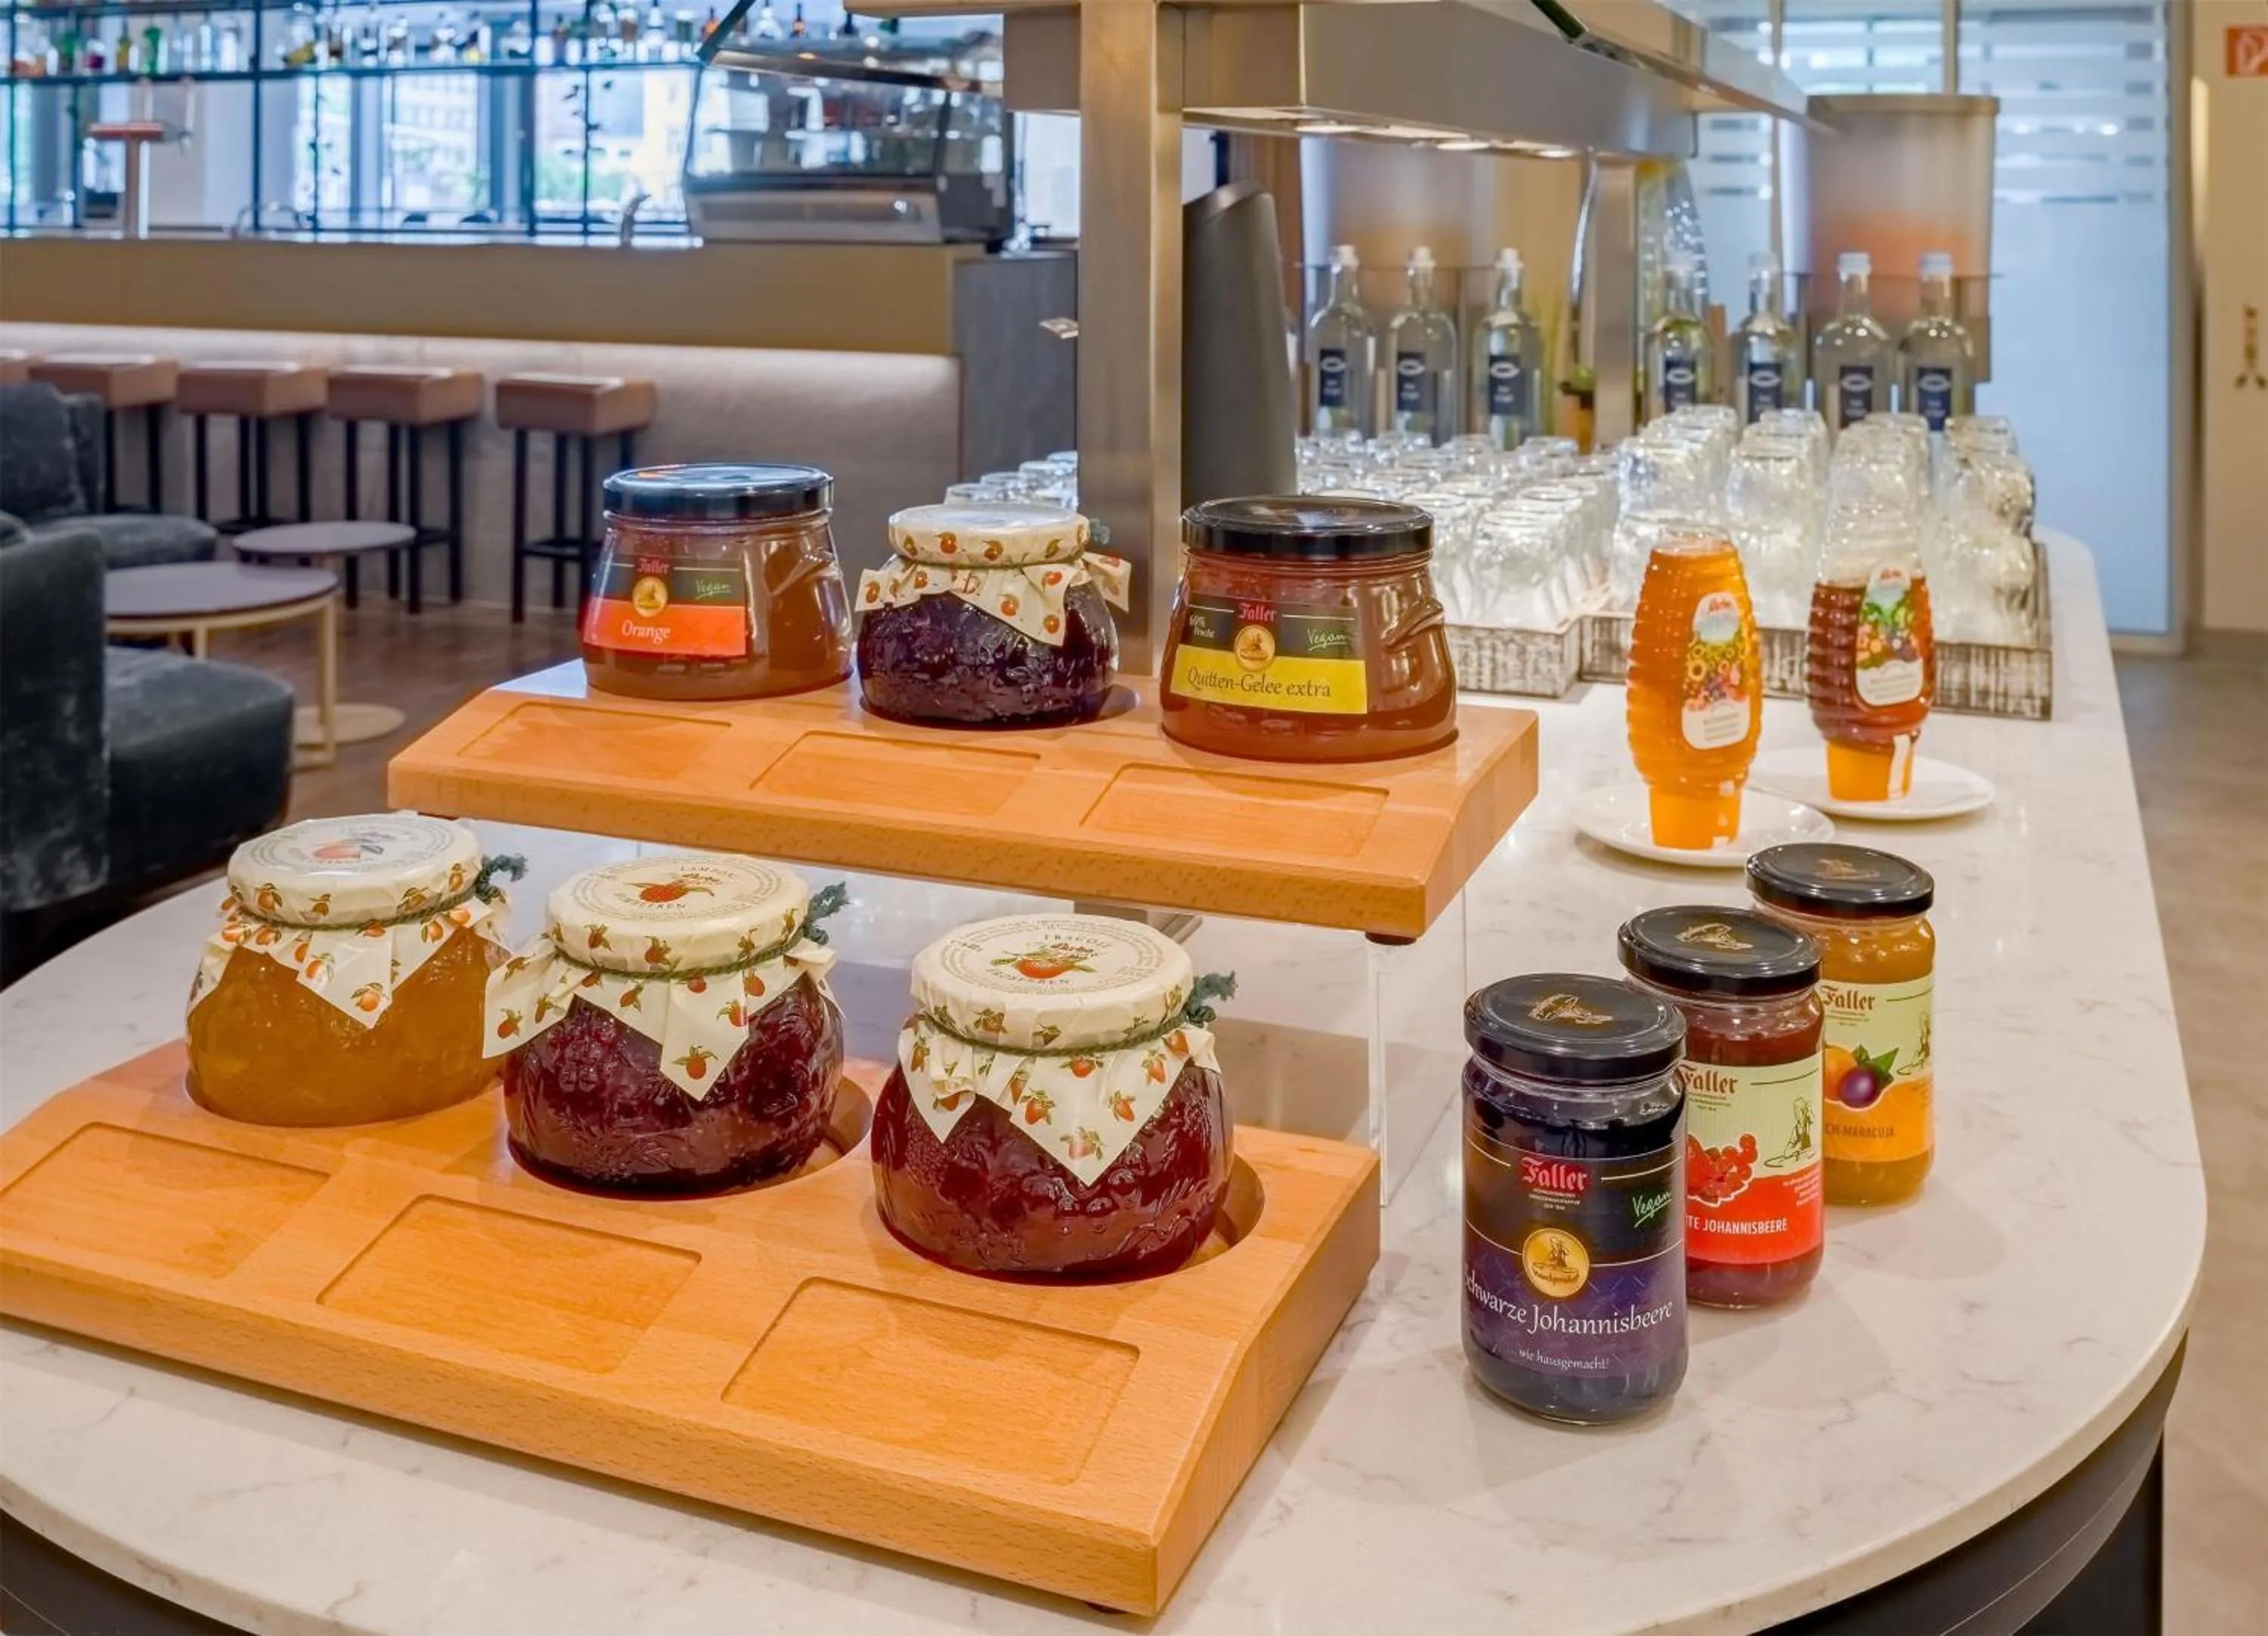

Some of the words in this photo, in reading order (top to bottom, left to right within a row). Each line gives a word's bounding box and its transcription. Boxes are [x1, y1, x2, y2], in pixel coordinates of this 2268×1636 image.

[1238, 603, 1277, 622] Faller
[621, 619, 671, 644] Orange
[1307, 628, 1347, 649] Vegan
[1188, 666, 1282, 695] Quitten-Gelee
[1287, 680, 1331, 697] extra
[1820, 985, 1876, 1011] Faller
[1521, 1156, 1588, 1191] Faller
[1632, 1191, 1672, 1222] Vegan
[1685, 1215, 1700, 1230] TE
[1702, 1218, 1788, 1235] JOHANNISBEERE
